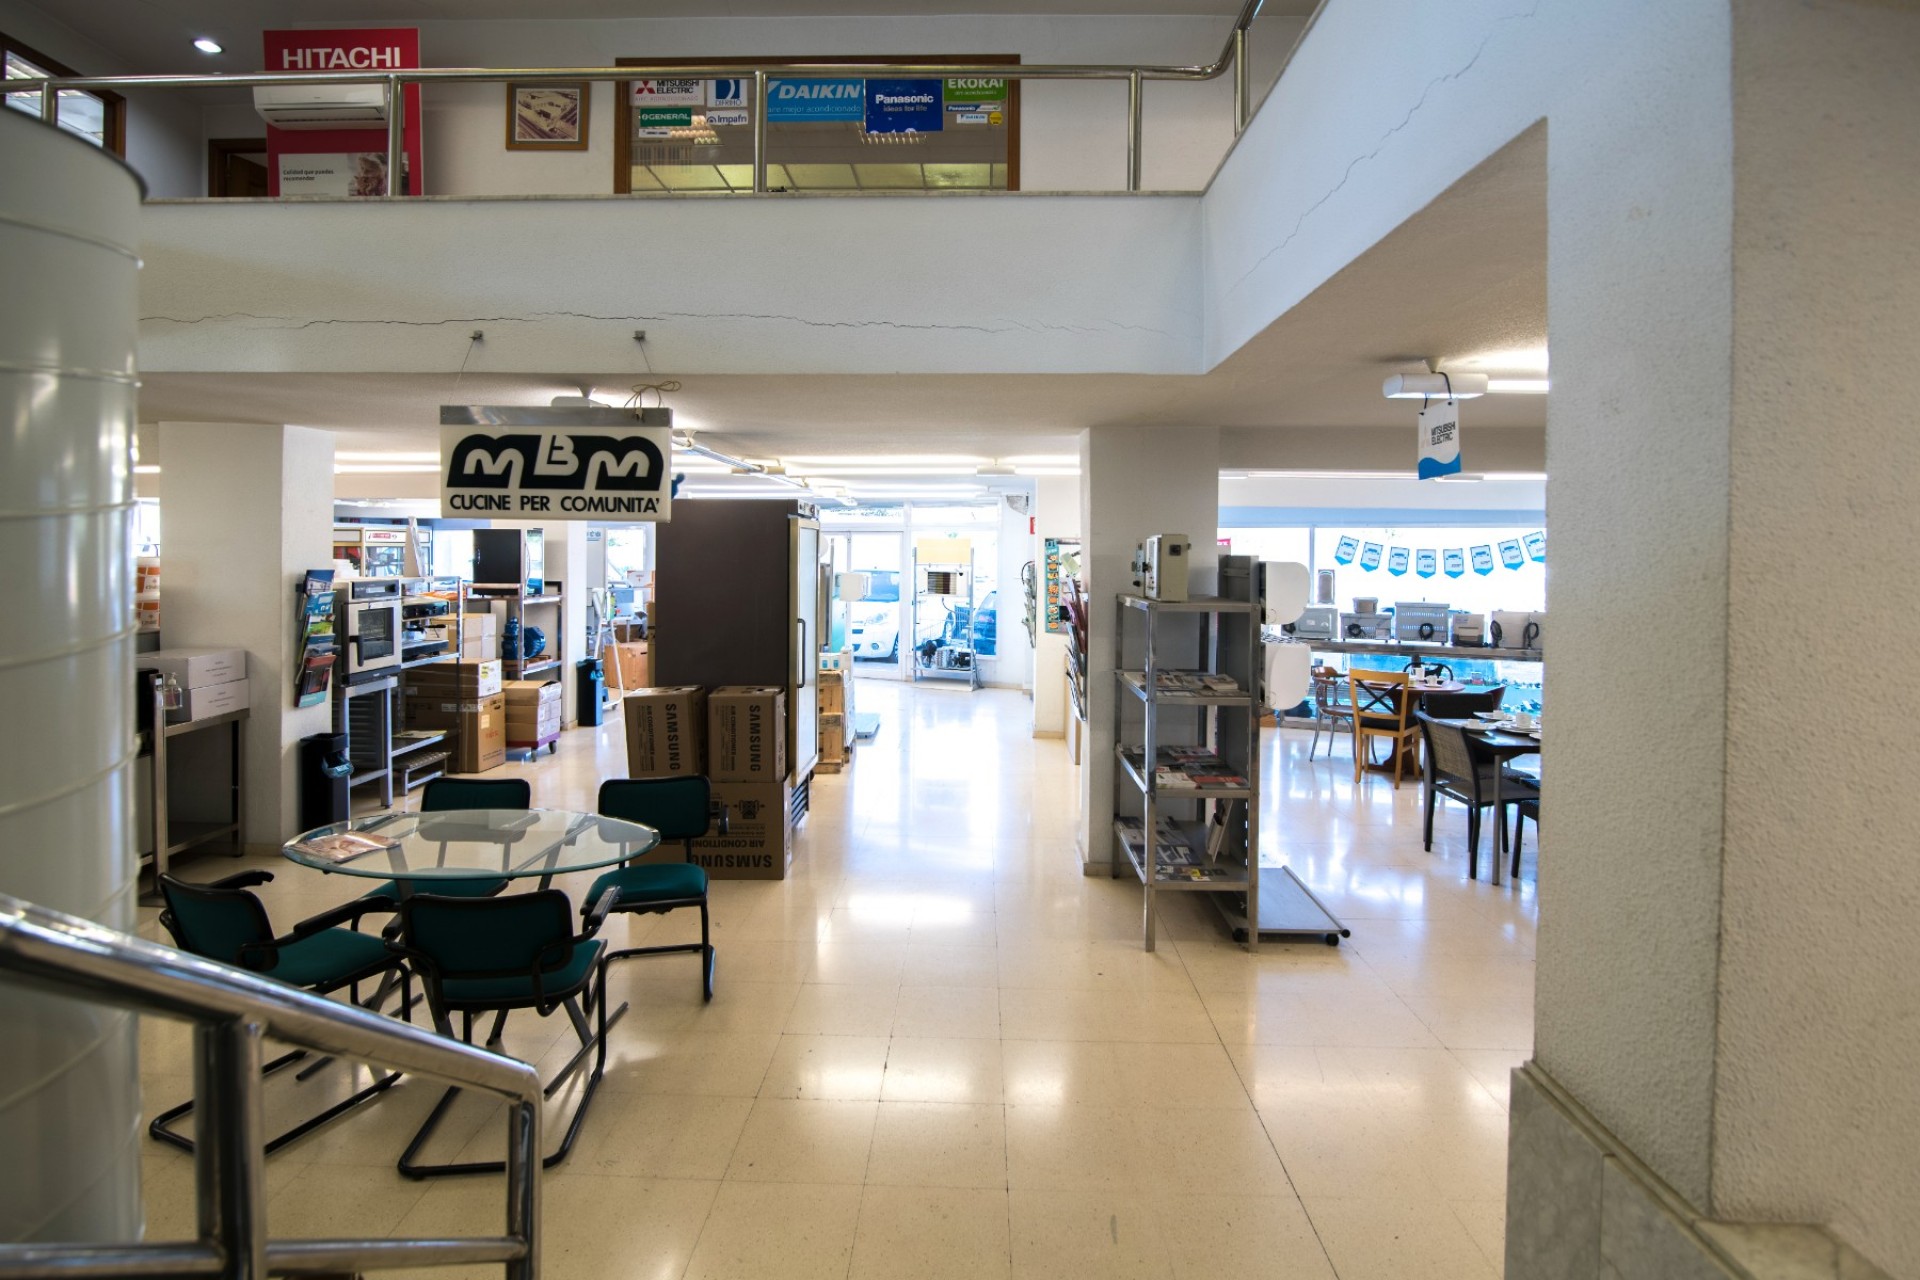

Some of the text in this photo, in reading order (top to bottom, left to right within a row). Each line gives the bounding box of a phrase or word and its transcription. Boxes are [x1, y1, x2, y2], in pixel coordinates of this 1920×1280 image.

[283, 47, 400, 68] HITACHI
[779, 85, 861, 99] DAIKIN
[876, 94, 934, 104] Panasonic
[1431, 421, 1456, 436] MITSUBISHI
[1431, 432, 1453, 446] ELECTRIC
[450, 494, 511, 511] CUCINE
[520, 495, 550, 511] PER
[665, 703, 681, 770] SAMSUNG
[749, 704, 761, 772] SAMSUNG
[749, 839, 765, 848] AIR
